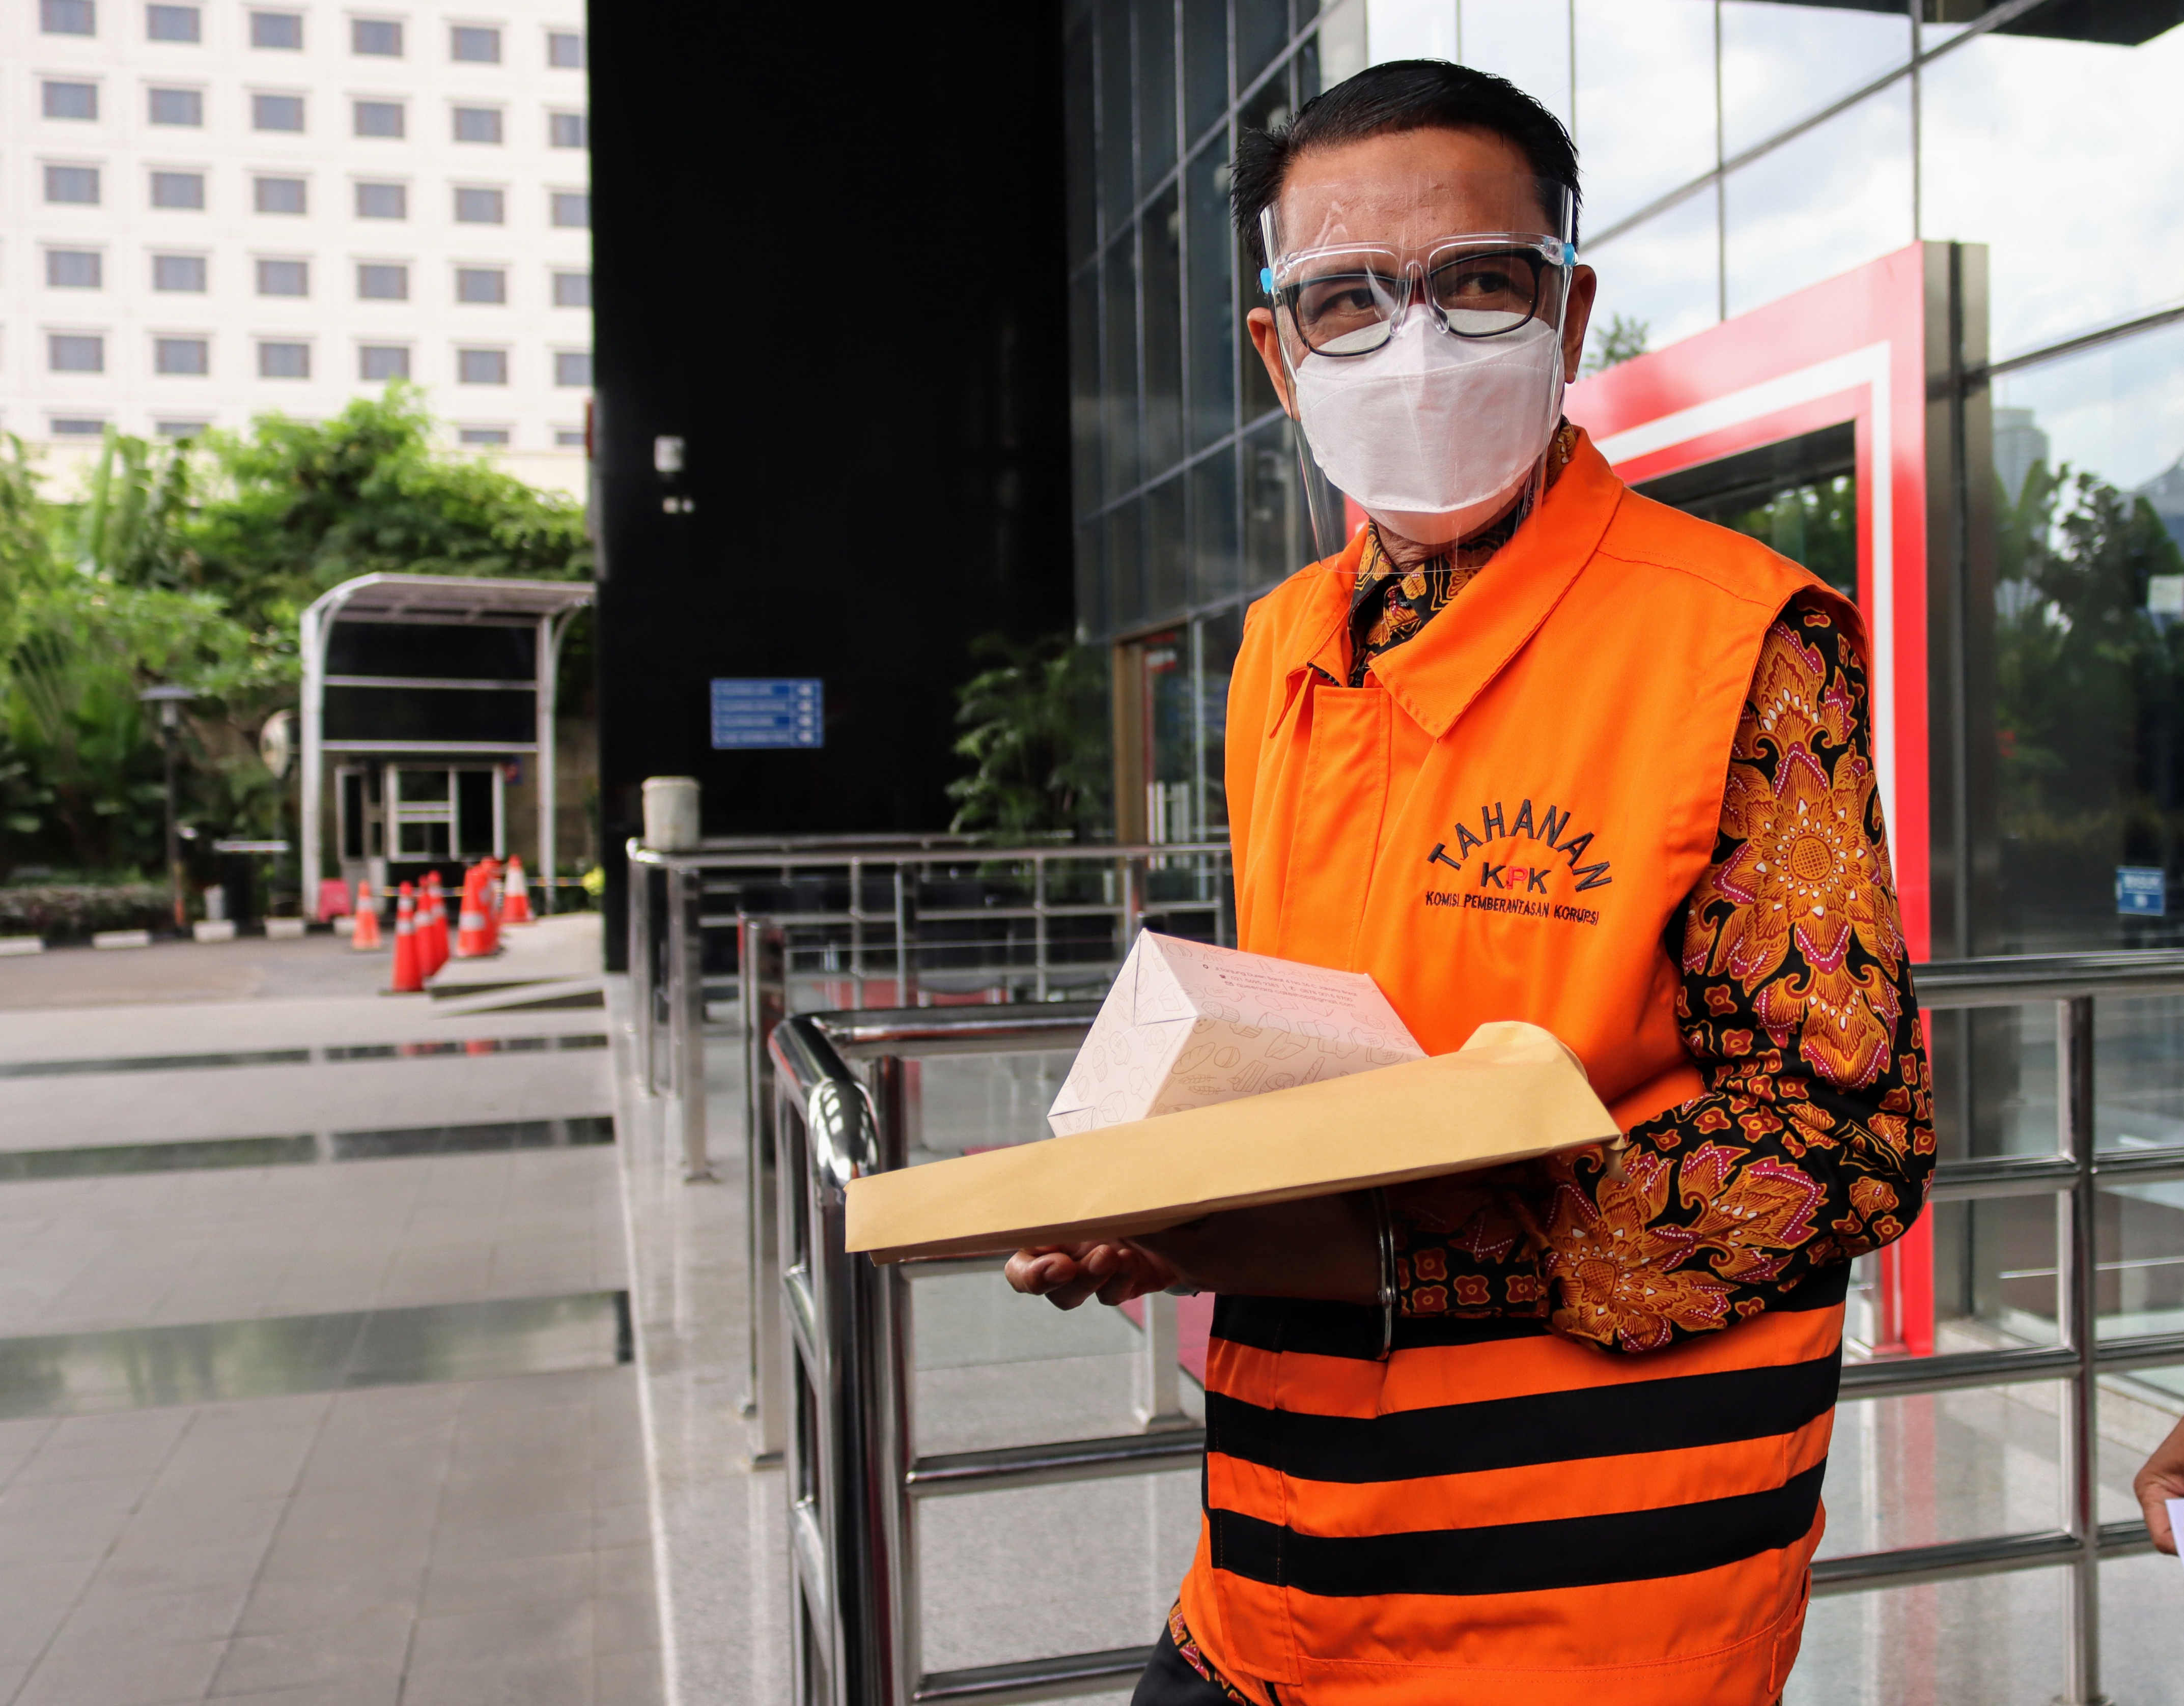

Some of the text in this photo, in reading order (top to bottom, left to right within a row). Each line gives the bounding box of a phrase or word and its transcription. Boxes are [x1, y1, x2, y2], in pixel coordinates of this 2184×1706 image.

[1427, 799, 1612, 893] TAHANAN
[1480, 862, 1551, 894] KPK
[1425, 891, 1600, 925] KOMISI PEMBERANTASAN KORUPSI
